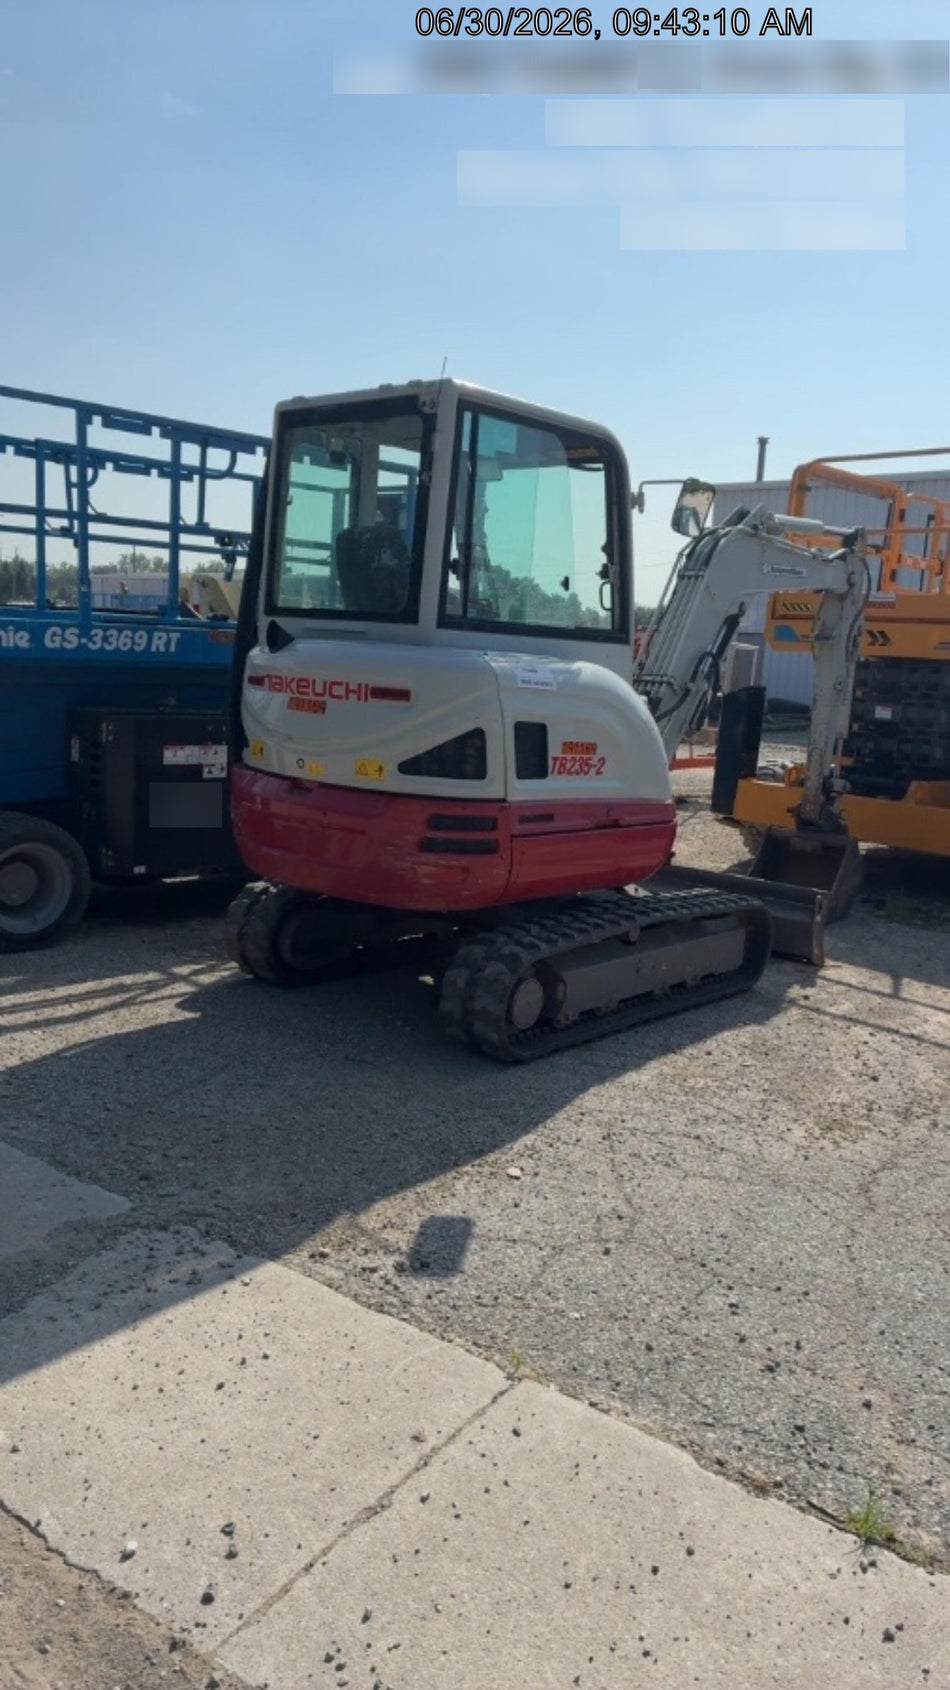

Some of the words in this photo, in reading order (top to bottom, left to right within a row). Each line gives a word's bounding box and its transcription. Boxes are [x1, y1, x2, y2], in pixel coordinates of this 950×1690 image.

[43, 626, 148, 652] GS-3369
[151, 631, 181, 653] RT
[551, 756, 606, 777] TB235-2
